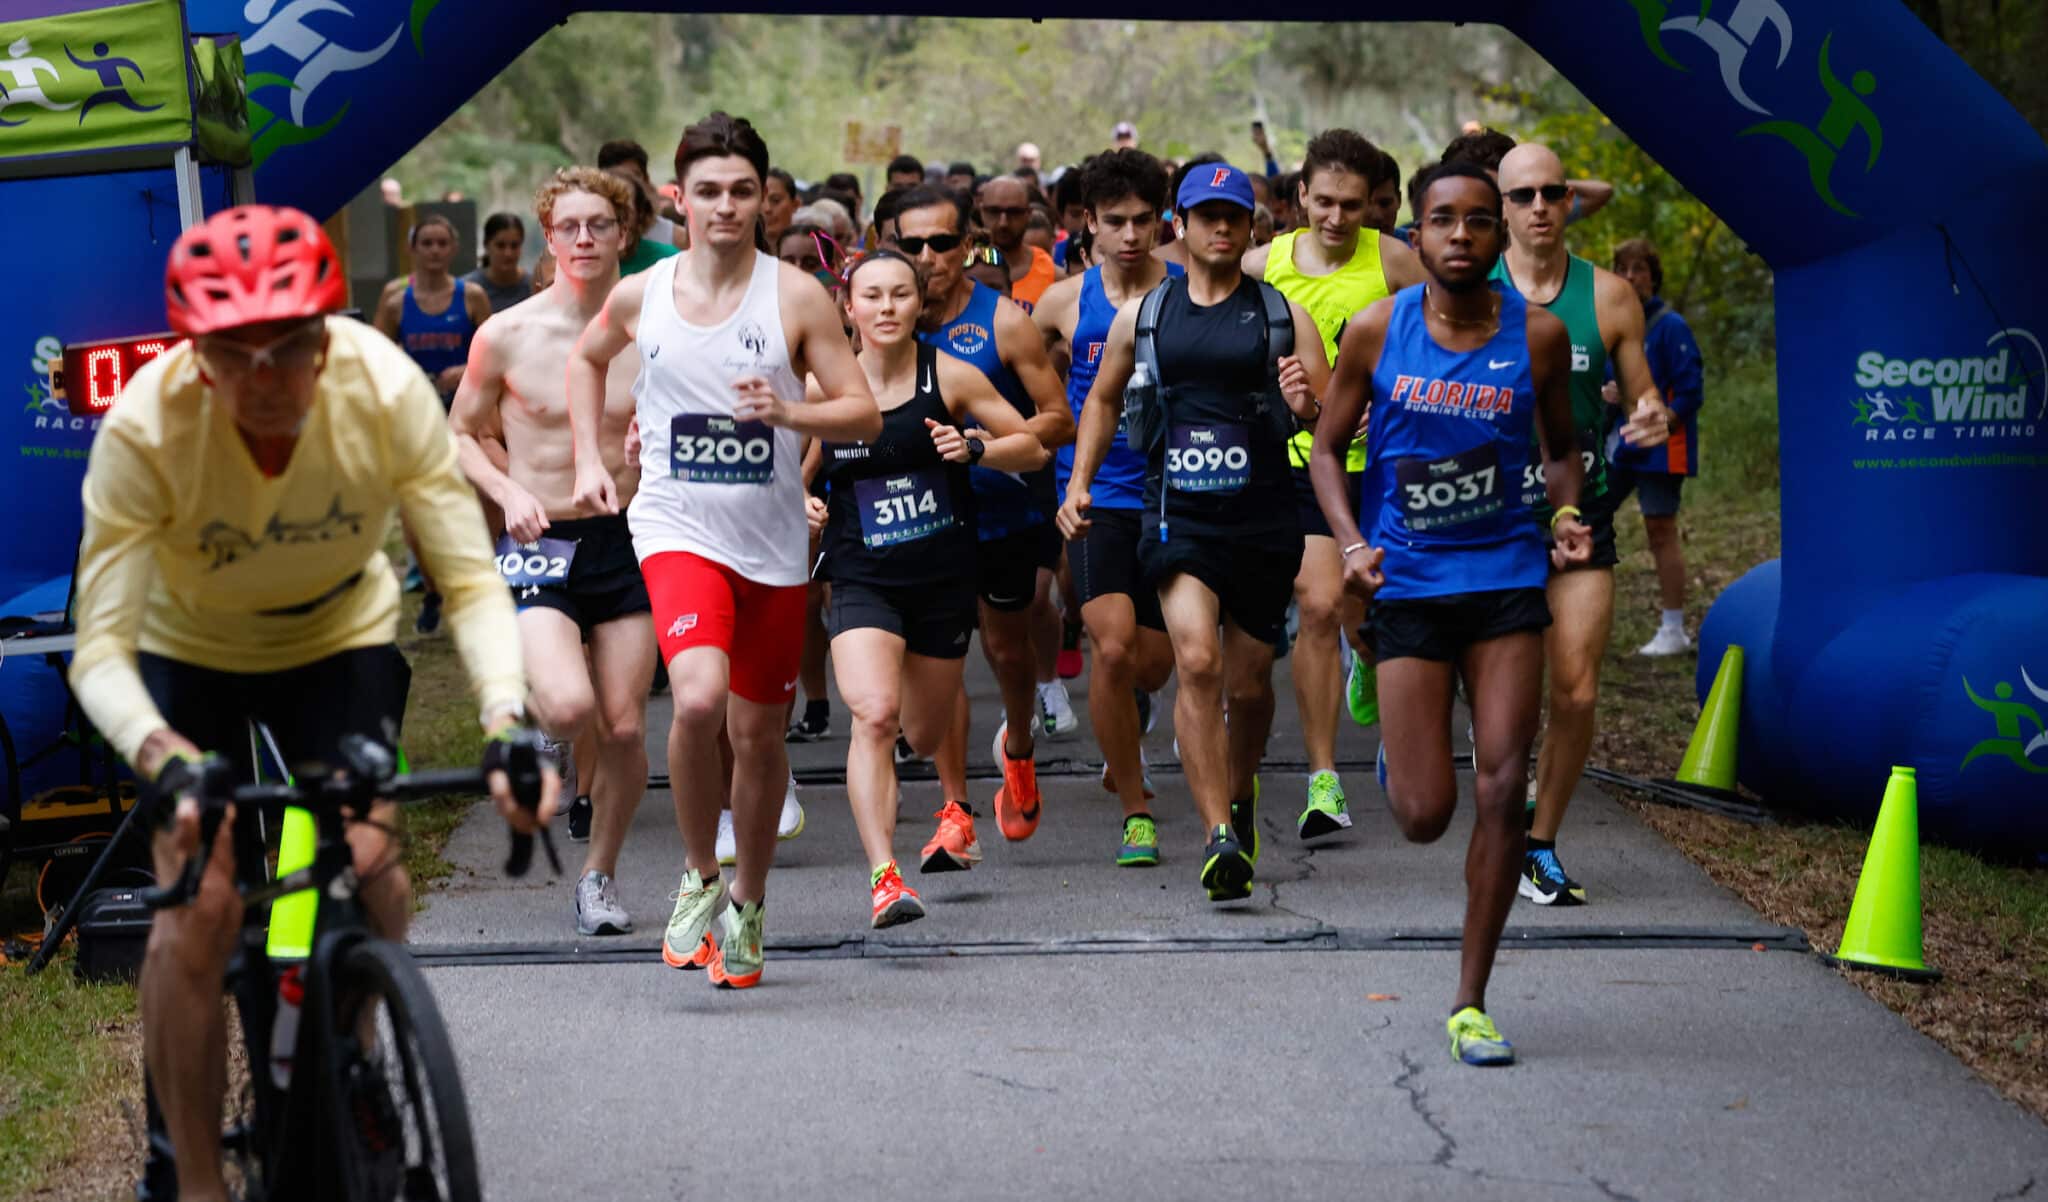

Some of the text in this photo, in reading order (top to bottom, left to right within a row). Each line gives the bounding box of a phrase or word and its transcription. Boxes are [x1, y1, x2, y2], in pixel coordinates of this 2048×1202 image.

[1210, 167, 1231, 187] F
[949, 323, 988, 341] BOSTON
[1855, 349, 2009, 388] Second
[1391, 374, 1514, 415] FLORIDA
[1931, 385, 2028, 422] Wind
[1404, 400, 1496, 421] RUNNING CLUB
[1865, 424, 2036, 441] RACE TIMING
[674, 434, 771, 465] 3200
[1168, 445, 1248, 473] 3090
[1405, 465, 1496, 511] 3037
[873, 488, 938, 526] 3114
